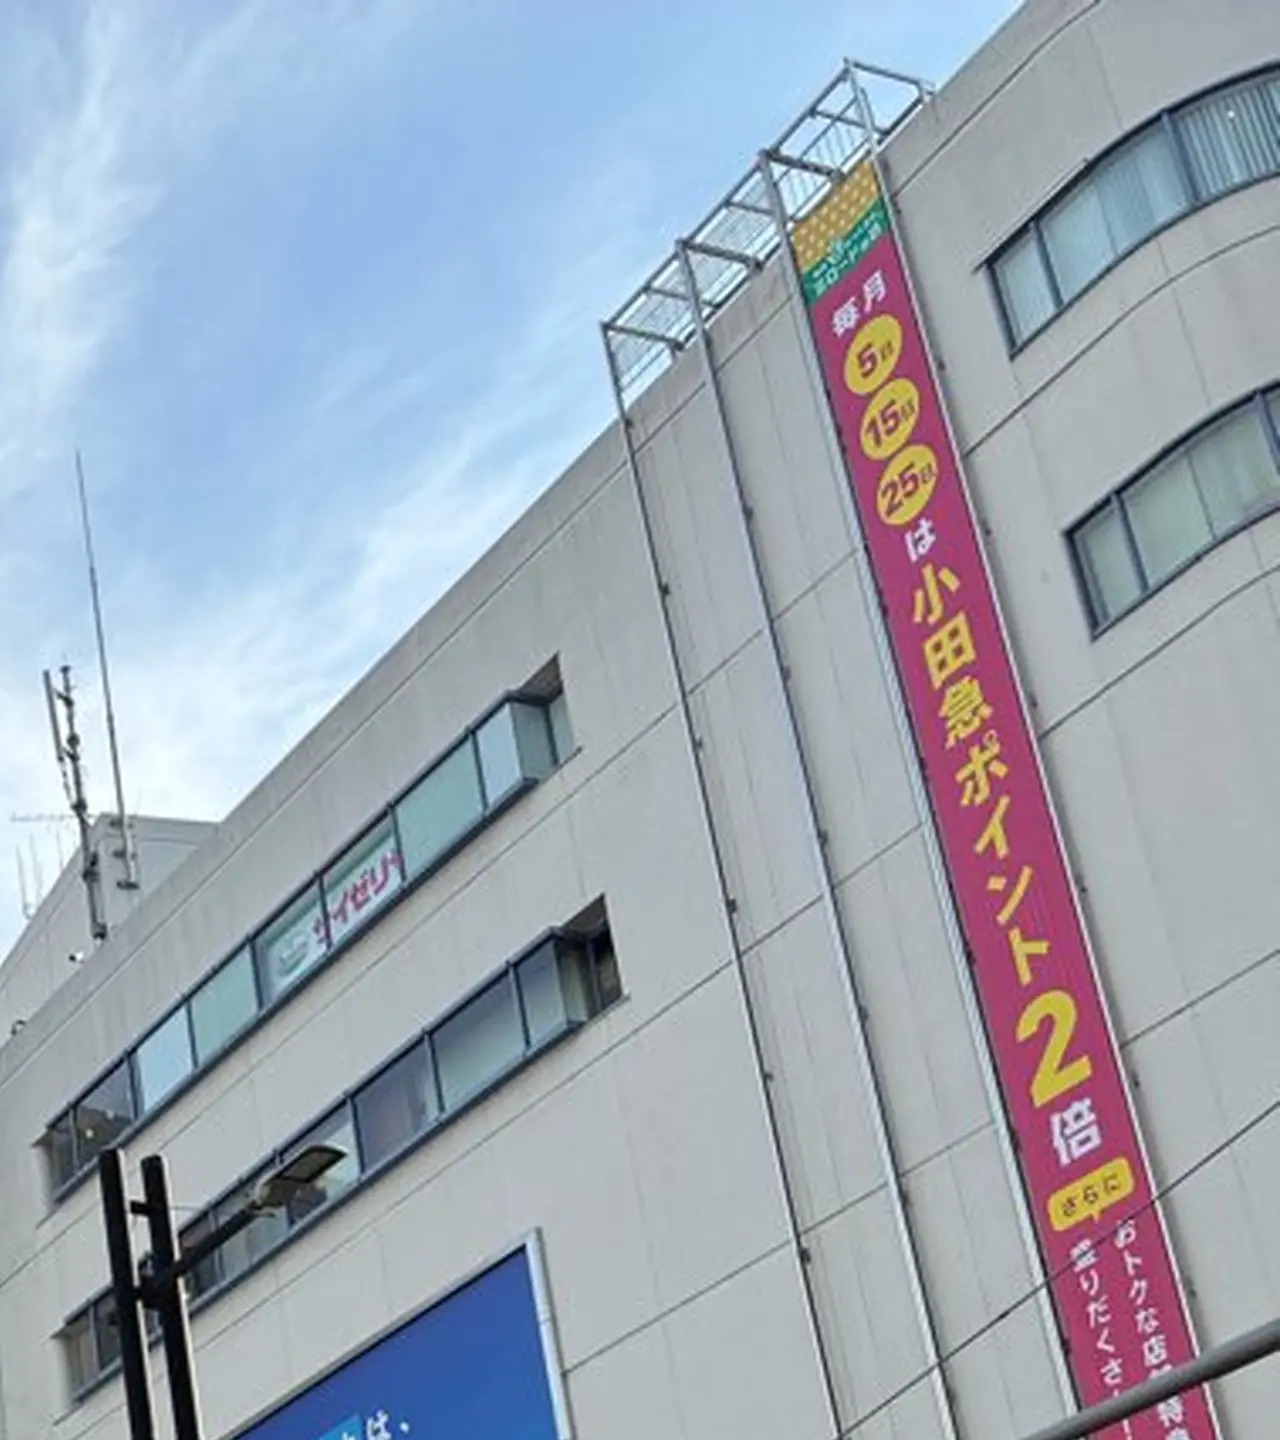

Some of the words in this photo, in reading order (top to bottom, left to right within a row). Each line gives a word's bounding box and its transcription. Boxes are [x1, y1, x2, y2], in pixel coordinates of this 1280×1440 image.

[831, 269, 888, 337] 毎月
[857, 341, 895, 380] 5日
[865, 397, 915, 450] 15日
[882, 463, 934, 518] 25日
[1060, 1173, 1121, 1218] さらに
